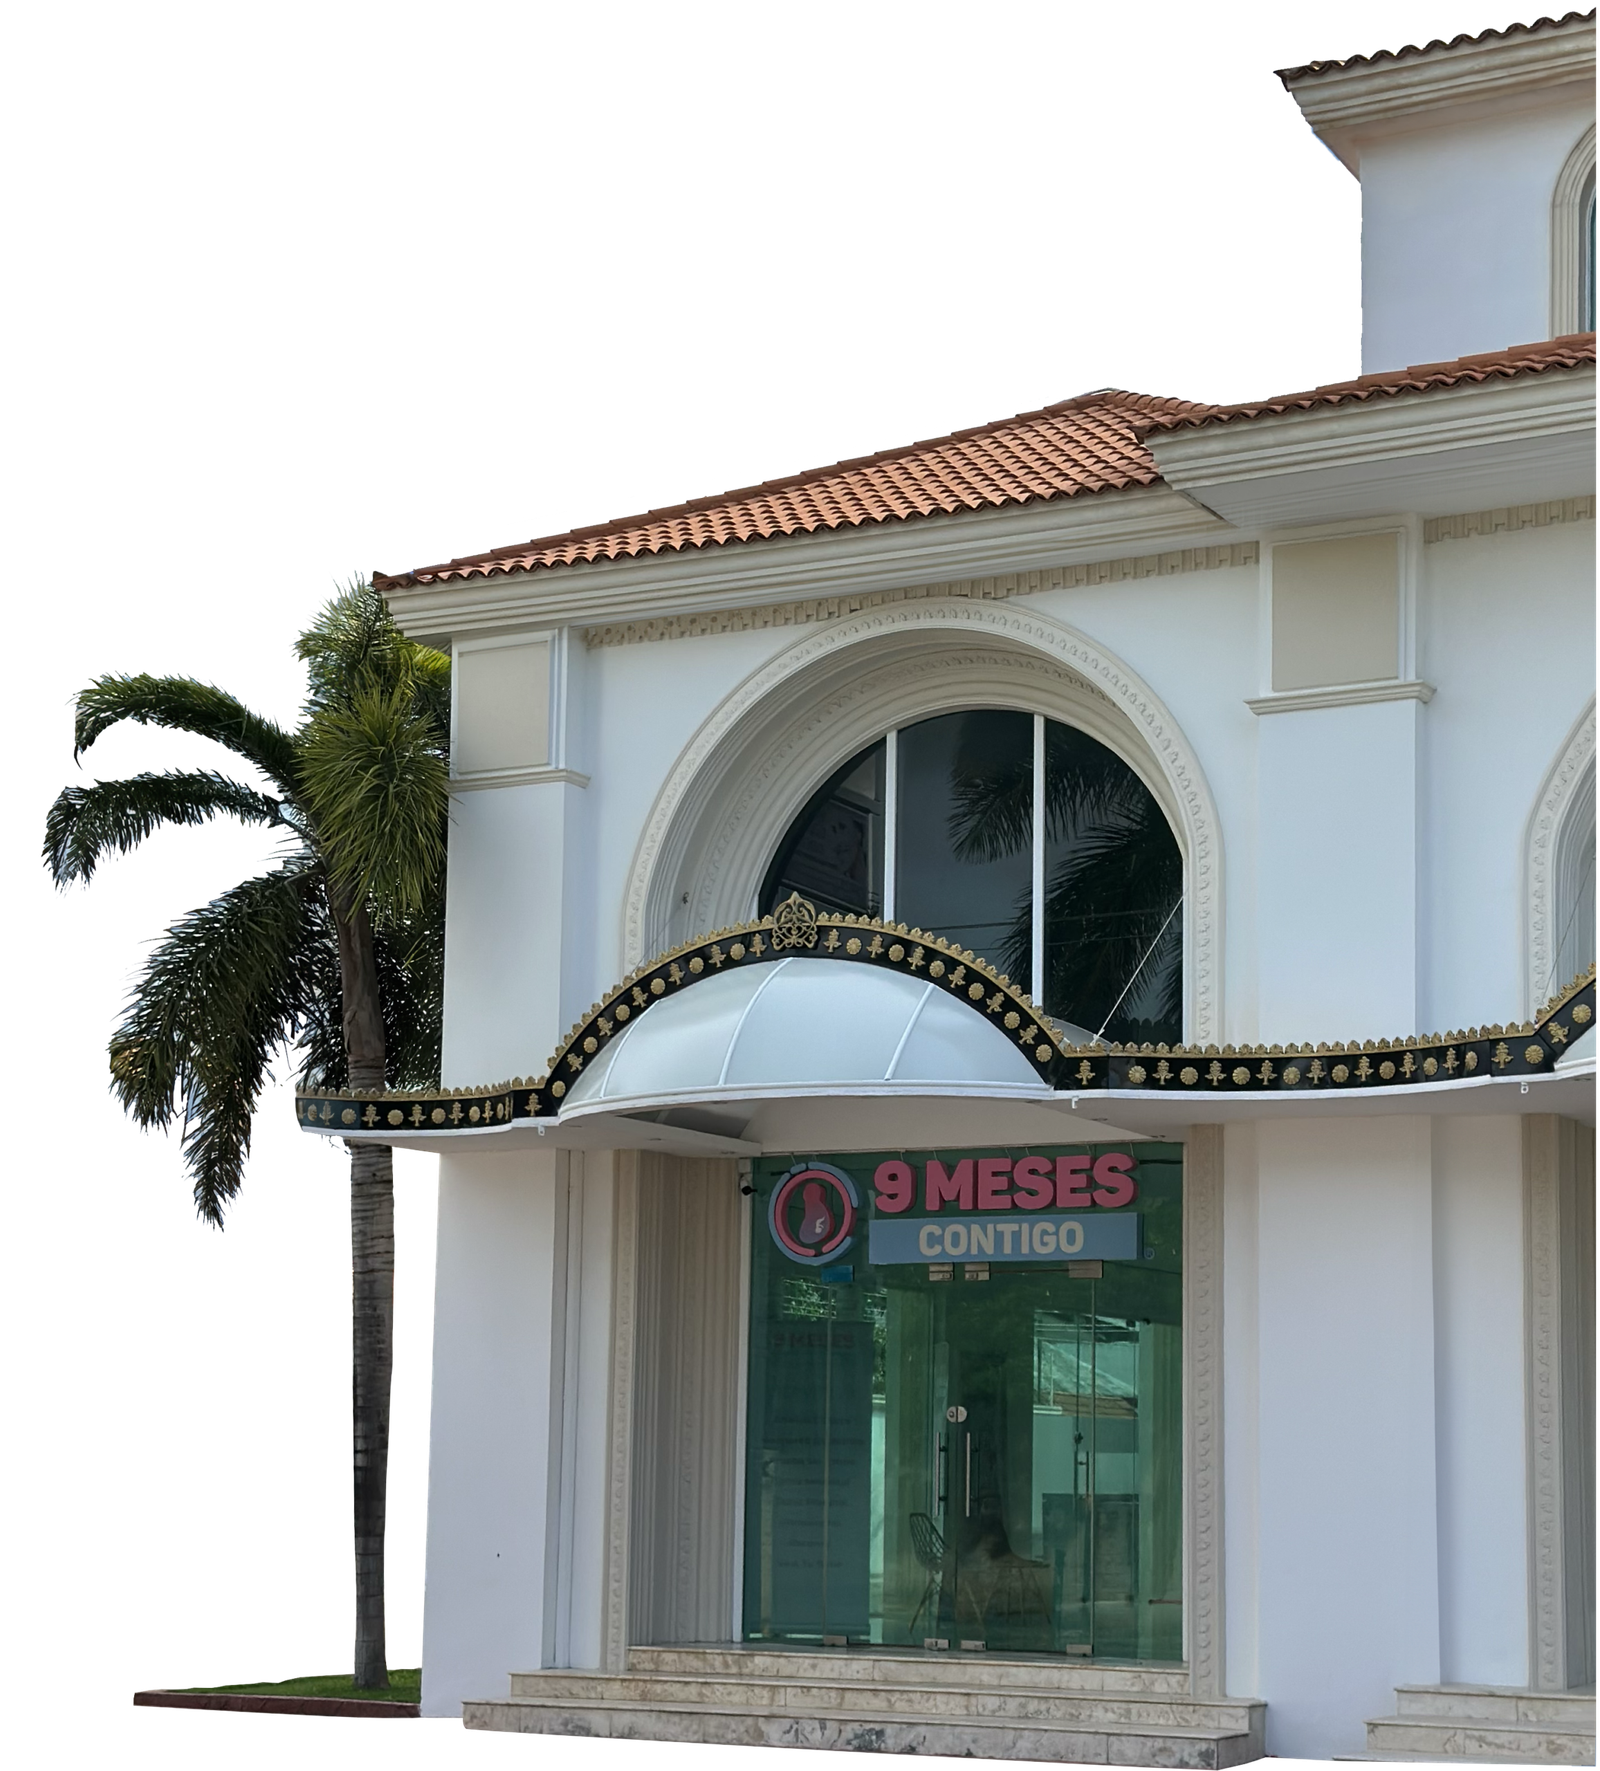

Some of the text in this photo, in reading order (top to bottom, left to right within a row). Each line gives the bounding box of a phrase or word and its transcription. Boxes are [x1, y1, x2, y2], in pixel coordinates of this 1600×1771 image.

[873, 1153, 1137, 1214] 9 MESES
[918, 1220, 1085, 1257] CONTIGO
